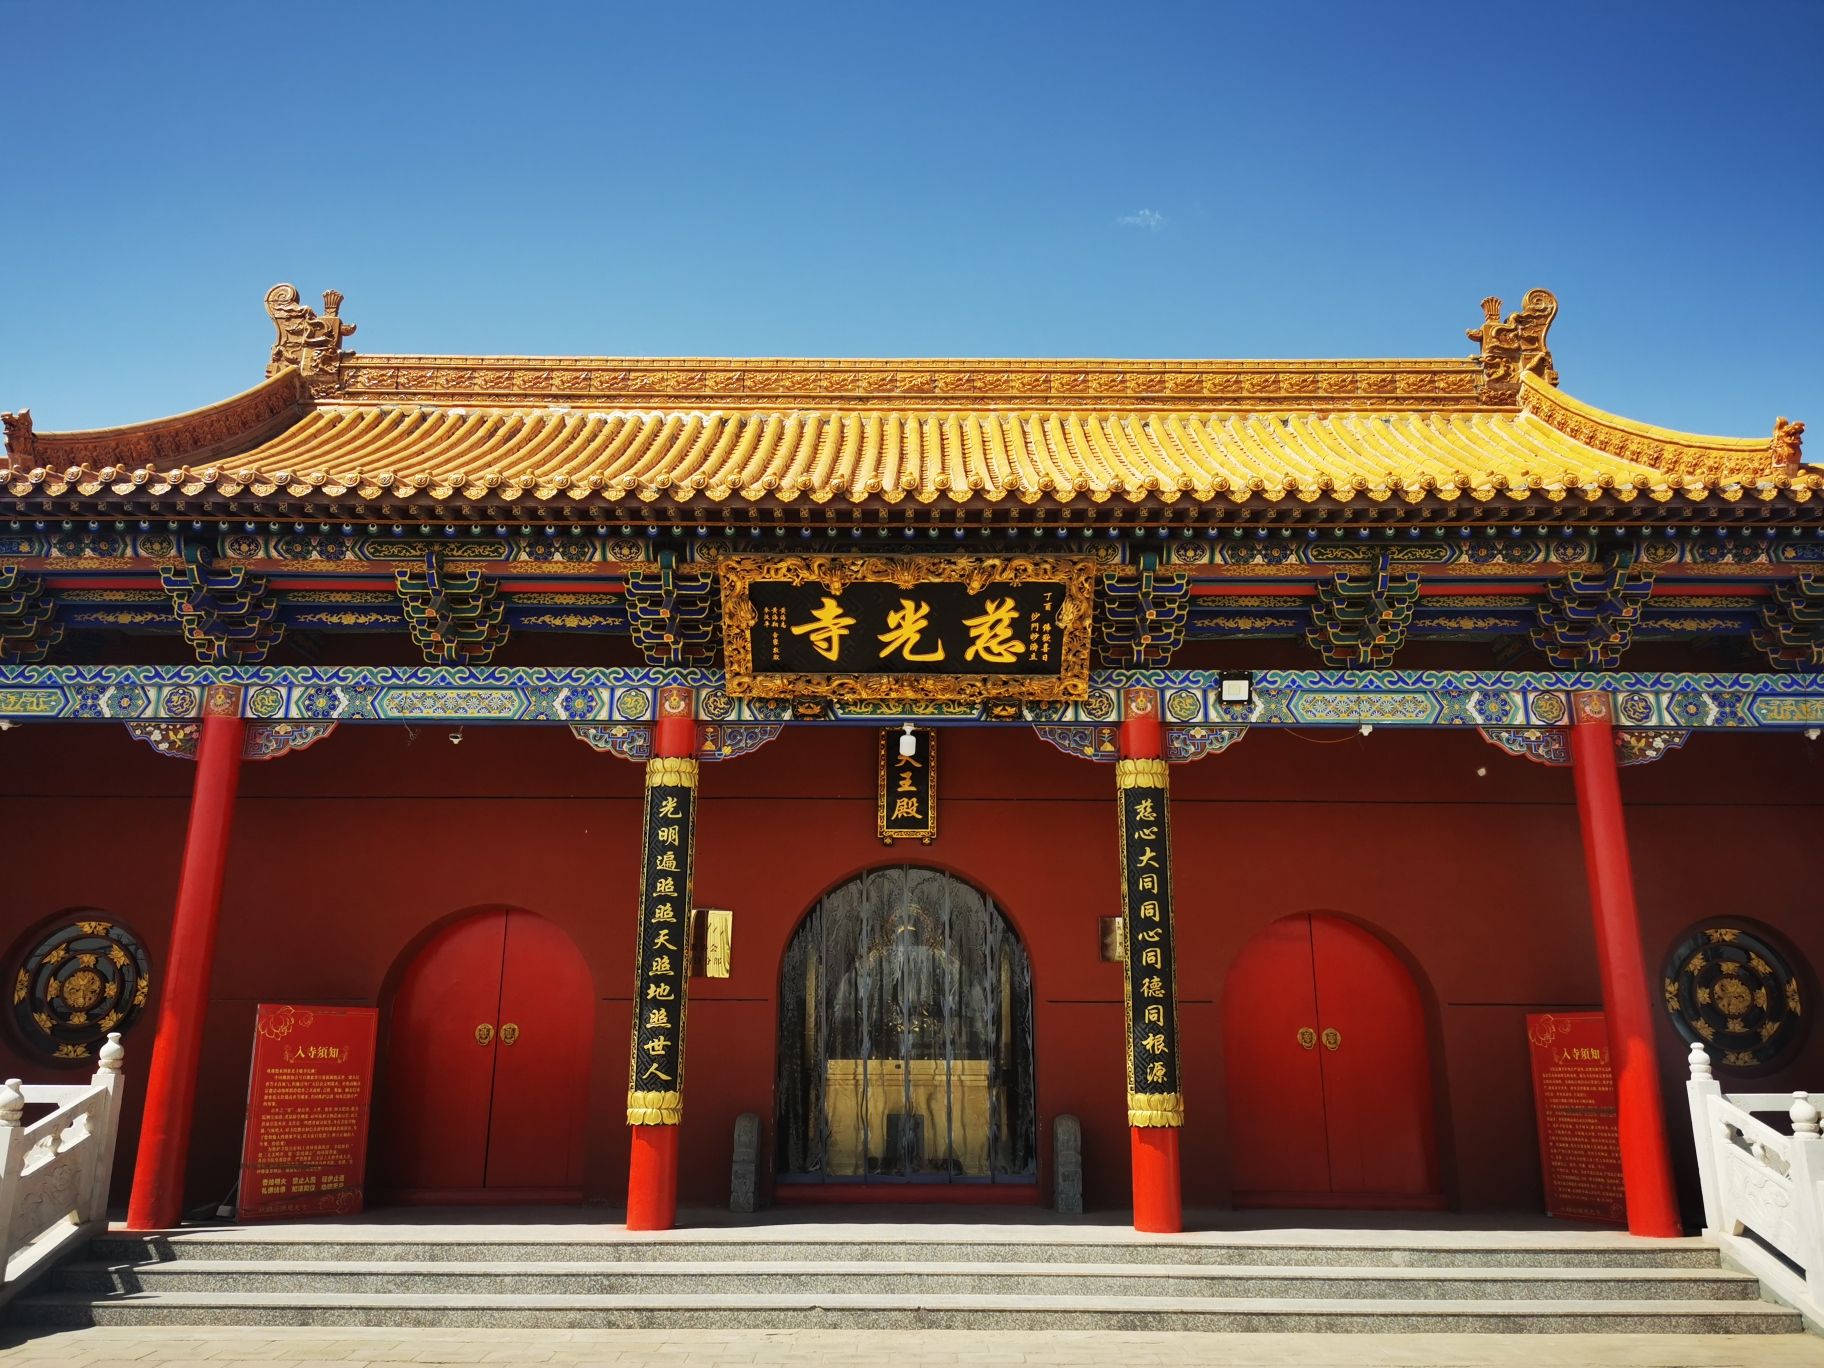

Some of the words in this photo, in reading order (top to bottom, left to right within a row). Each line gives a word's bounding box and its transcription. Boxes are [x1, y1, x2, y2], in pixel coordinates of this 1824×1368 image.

[790, 596, 1027, 664] 慈光寺
[642, 796, 683, 1082] 光明遍照照天照地照世人
[1134, 798, 1169, 1084] 慈心大同同心同德同根源
[294, 1045, 339, 1059] 入寺須知
